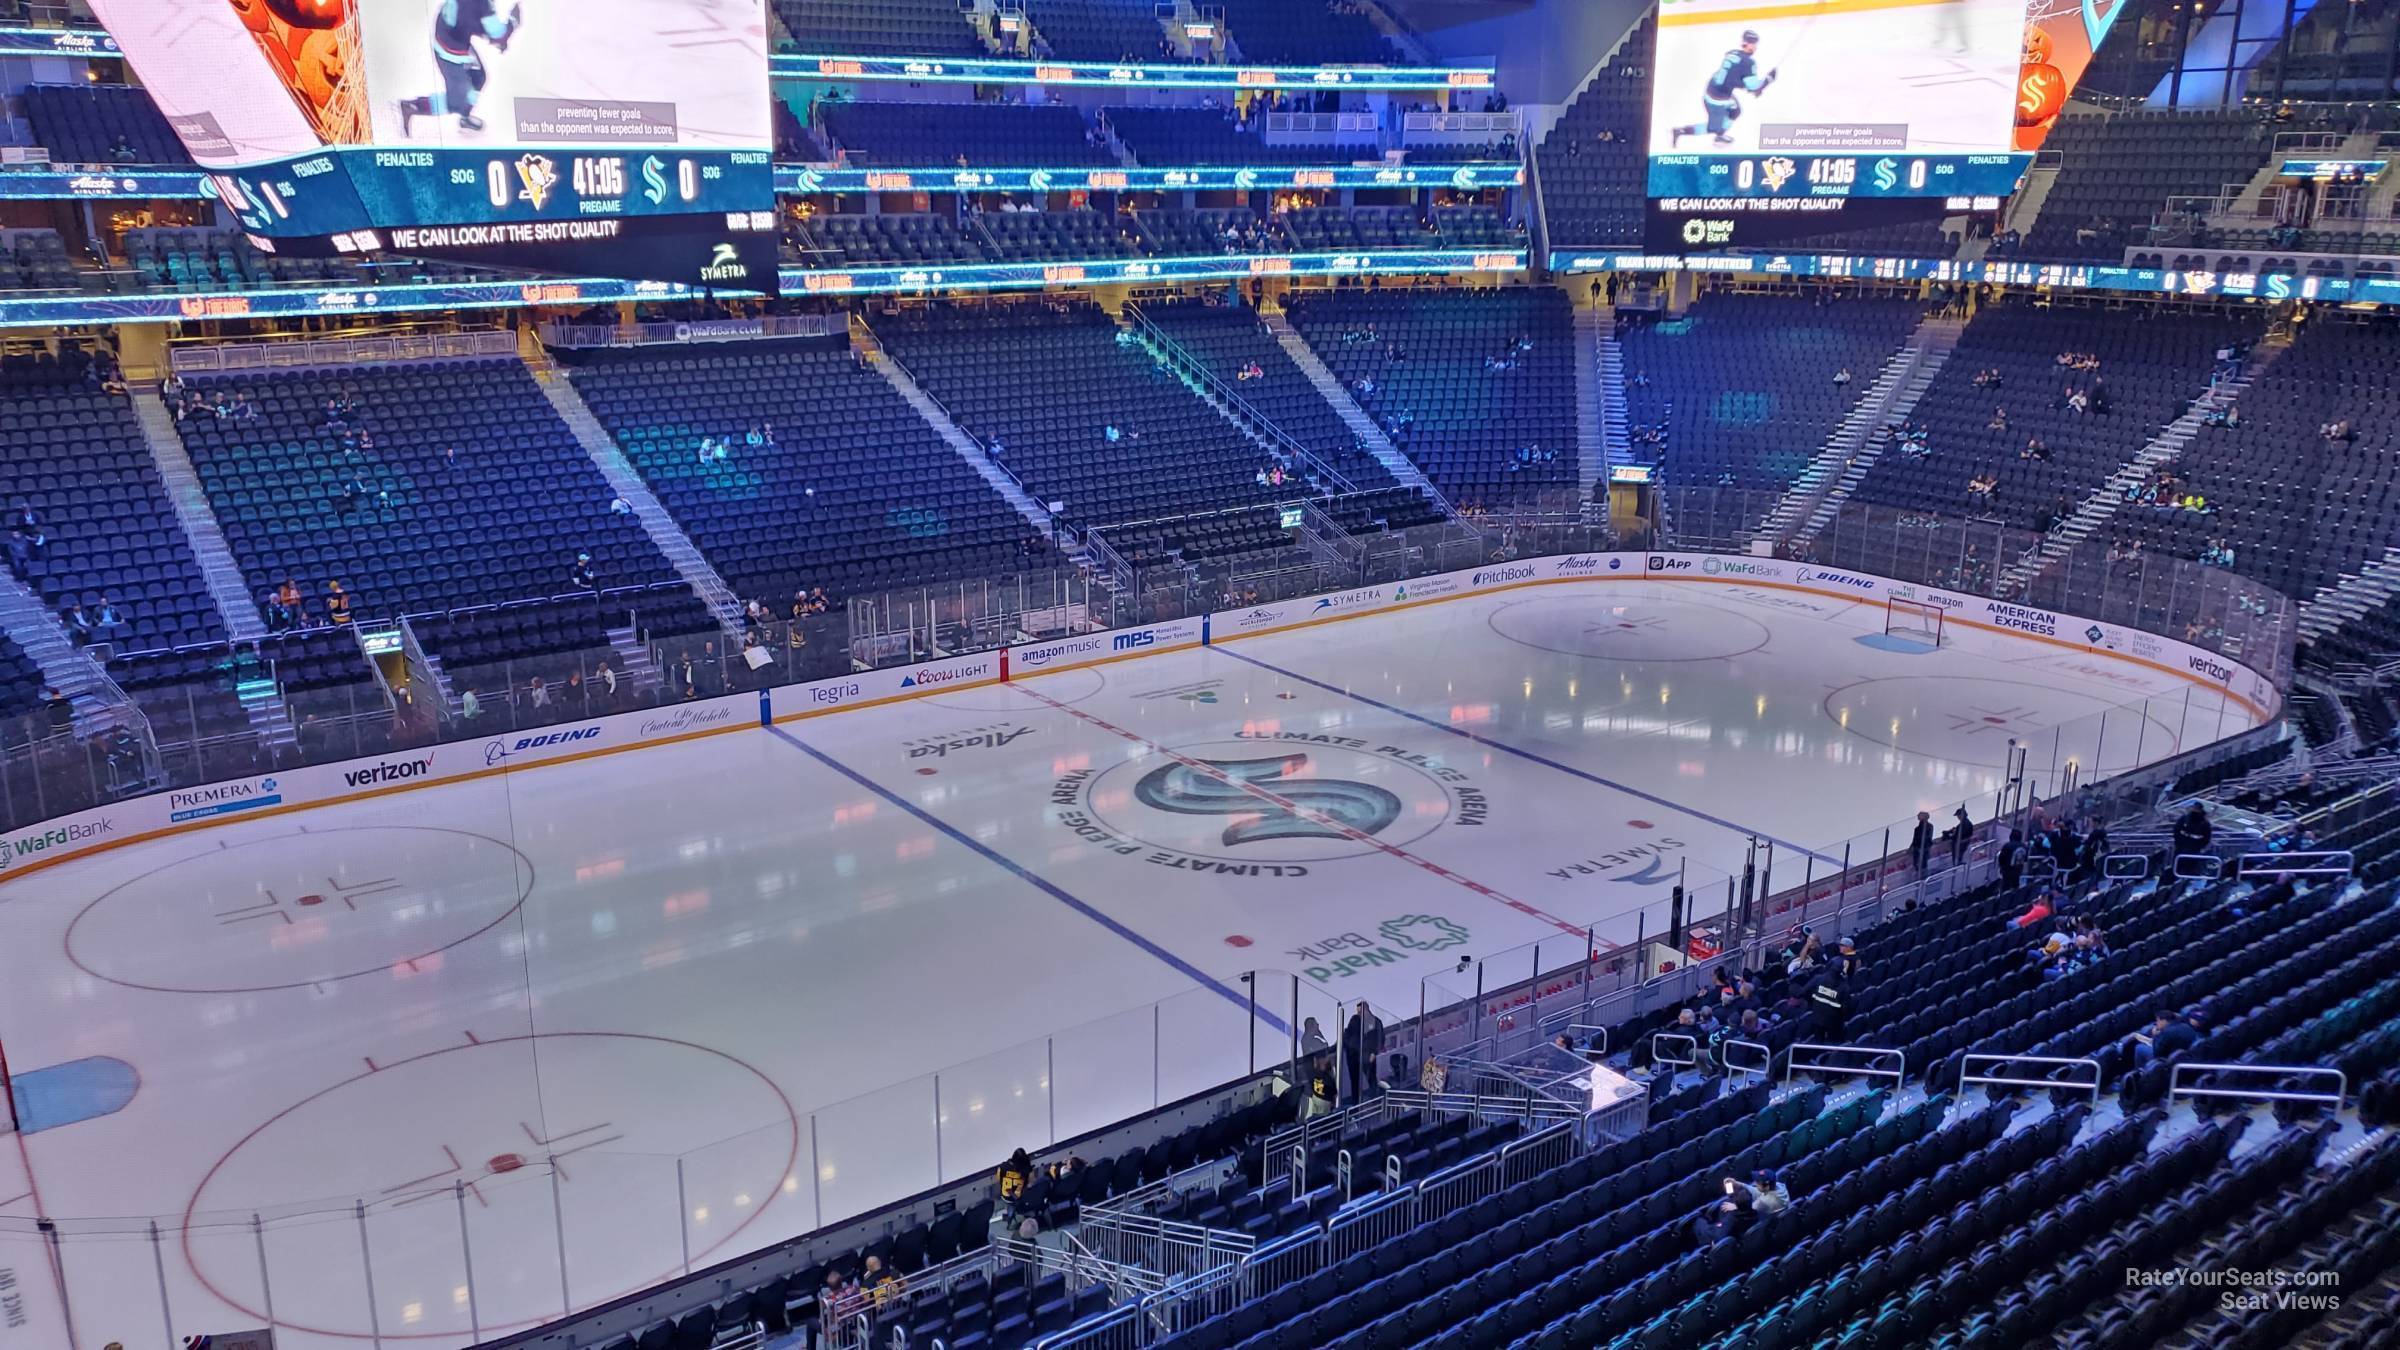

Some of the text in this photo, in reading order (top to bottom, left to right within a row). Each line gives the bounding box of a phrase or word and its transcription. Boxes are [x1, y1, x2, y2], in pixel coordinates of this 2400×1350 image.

[558, 107, 641, 121] preventing fewer goals
[521, 120, 675, 137] than the opponent was expected to score,
[1796, 128, 1872, 138] preventing fewer goals
[1763, 137, 1779, 145] than
[1780, 137, 1791, 145] the
[1792, 138, 1825, 147] opponent
[1842, 138, 1872, 147] expected
[292, 157, 333, 178] PENALTIES
[376, 153, 434, 167] PENALTIES
[731, 153, 767, 164] PENALTIES
[1658, 156, 1699, 165] PENALTIES
[1968, 156, 2009, 164] PENALTIES
[451, 158, 720, 206] SOG 0 41:05 0 SOG
[1710, 159, 1954, 188] SOG 0 41:05 0 SOG
[1812, 186, 1849, 195] PREGAME
[580, 200, 621, 213] PREGAME
[1660, 198, 1845, 210] WE CAN LOOK AT THE SHOT QUALITY
[392, 230, 416, 248] WE
[419, 229, 449, 246] CAN
[451, 227, 488, 245] LOOK
[490, 226, 508, 242] AT
[508, 224, 534, 241] THE
[535, 223, 569, 240] SHOT
[570, 220, 618, 237] QUALITY
[1707, 220, 1734, 231] WaFd
[1707, 231, 1729, 242] Bank
[700, 264, 746, 281] SYMETRA
[1615, 256, 1644, 268] THANK
[1645, 256, 1664, 269] YOU
[1708, 257, 1753, 270] PARTNERS
[2139, 271, 2154, 279] SOG
[2164, 272, 2177, 290] 0
[2303, 278, 2318, 297] 0
[2331, 281, 2349, 289] SOG
[1557, 556, 1598, 570] Alaska
[1724, 563, 1782, 577] WaFd Bank
[1481, 565, 1535, 586] PitchBook
[1816, 571, 1875, 589] BOEING
[1333, 589, 1381, 606] SYMETRA
[1928, 594, 1963, 608] amazon
[1986, 602, 2056, 625] AMERICAN
[1995, 615, 2055, 636] EXPRESS
[1021, 638, 1101, 662] amazon music
[1114, 630, 1154, 650] MPS
[917, 663, 988, 686] Coors LIGHT
[2189, 655, 2232, 682] verizon
[809, 681, 859, 704] Tegria
[514, 726, 601, 751] BOEING
[910, 726, 1036, 759] Alaska
[344, 757, 426, 788] verizon
[1234, 731, 1488, 826] CLIMATE PLEDGE ARENA
[170, 783, 253, 810] PREMERA
[1052, 768, 1308, 877] CLIMATE PLEDGE ARENA
[14, 816, 113, 857] WaFd Bank
[1546, 838, 1685, 880] SYMETRA
[1285, 932, 1374, 961] Bank
[1303, 947, 1408, 983] WaFd
[2, 1293, 26, 1328] SINCE
